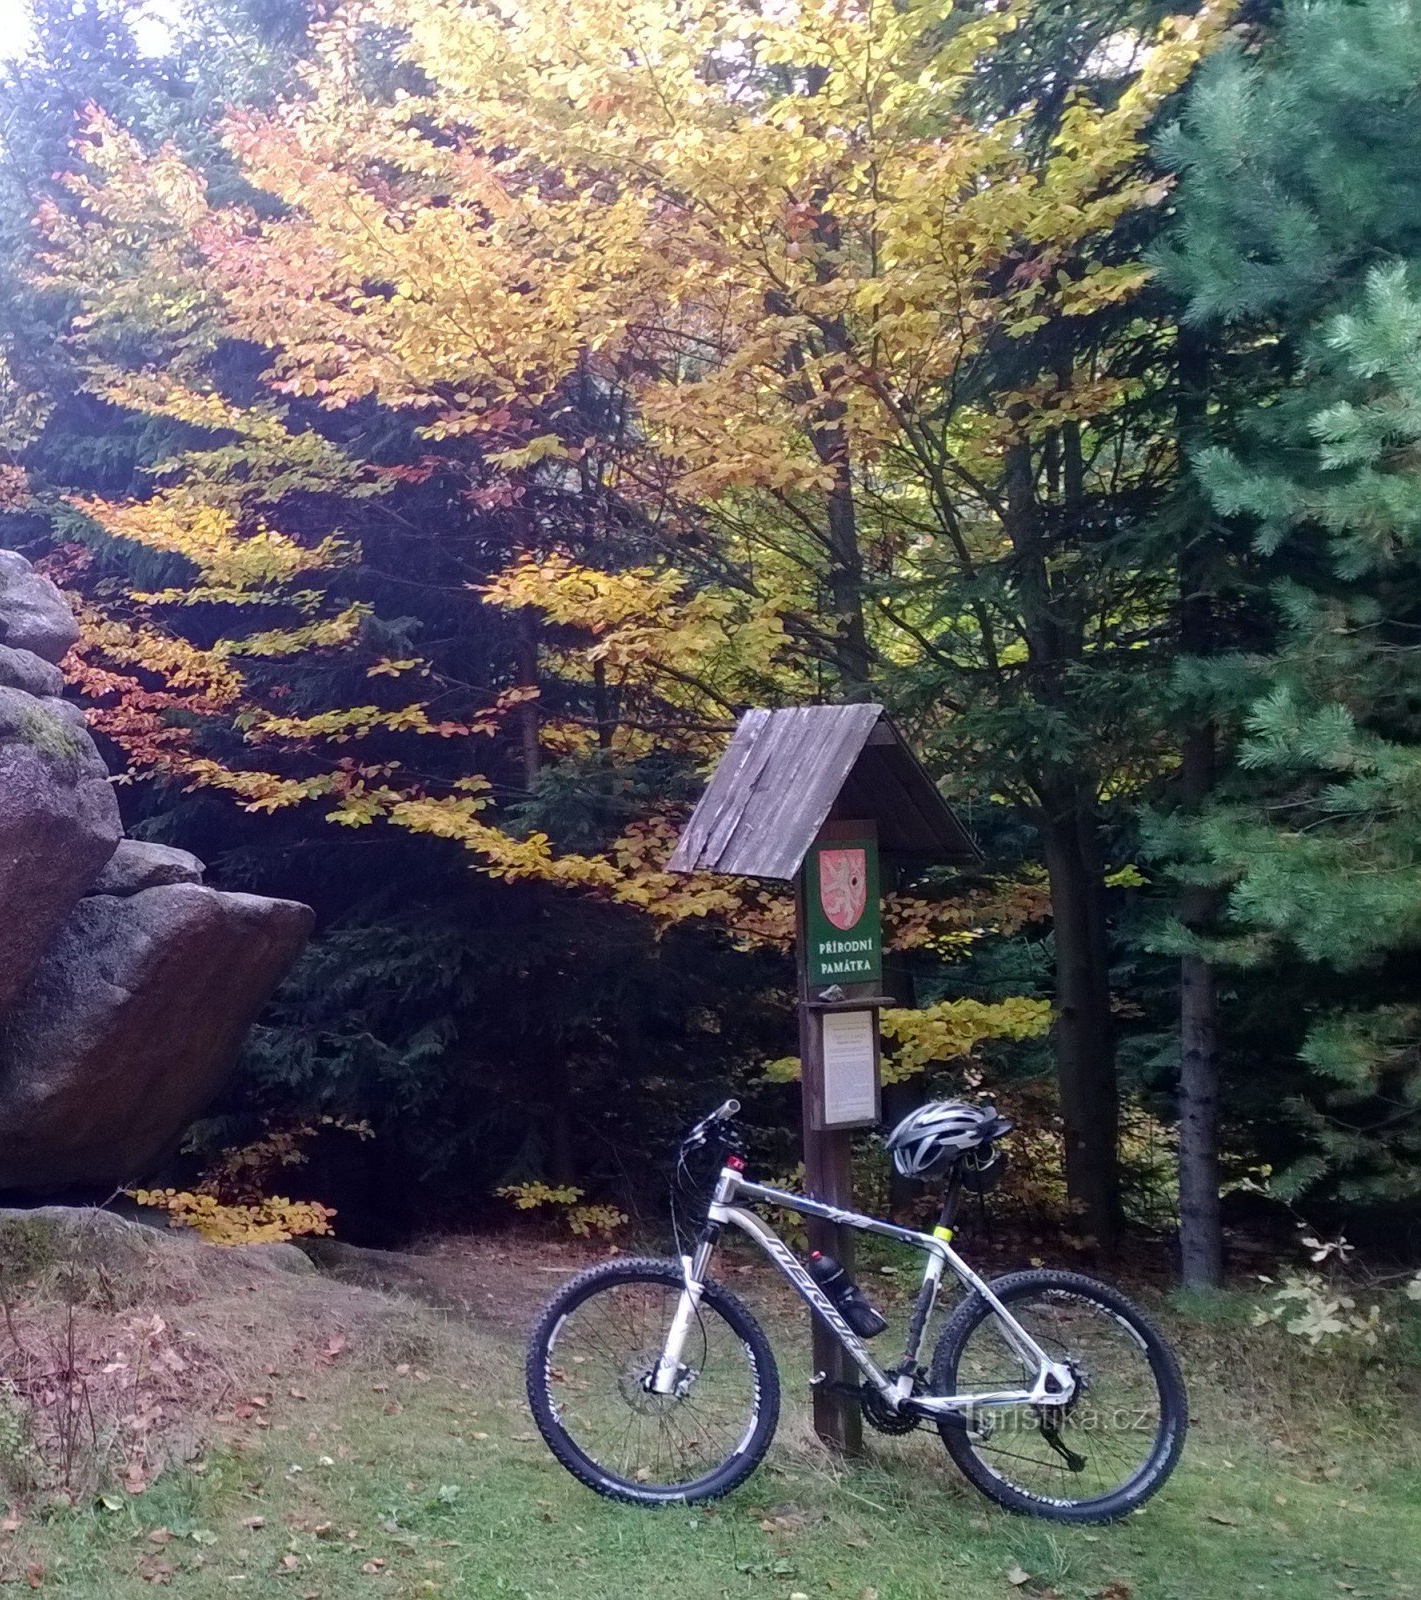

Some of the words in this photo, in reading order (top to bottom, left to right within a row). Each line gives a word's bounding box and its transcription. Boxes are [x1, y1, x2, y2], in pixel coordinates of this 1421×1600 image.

[819, 937, 873, 954] PŘÍRODNÍ
[821, 959, 871, 974] PAMÁTKA
[766, 1237, 864, 1353] MERIDA
